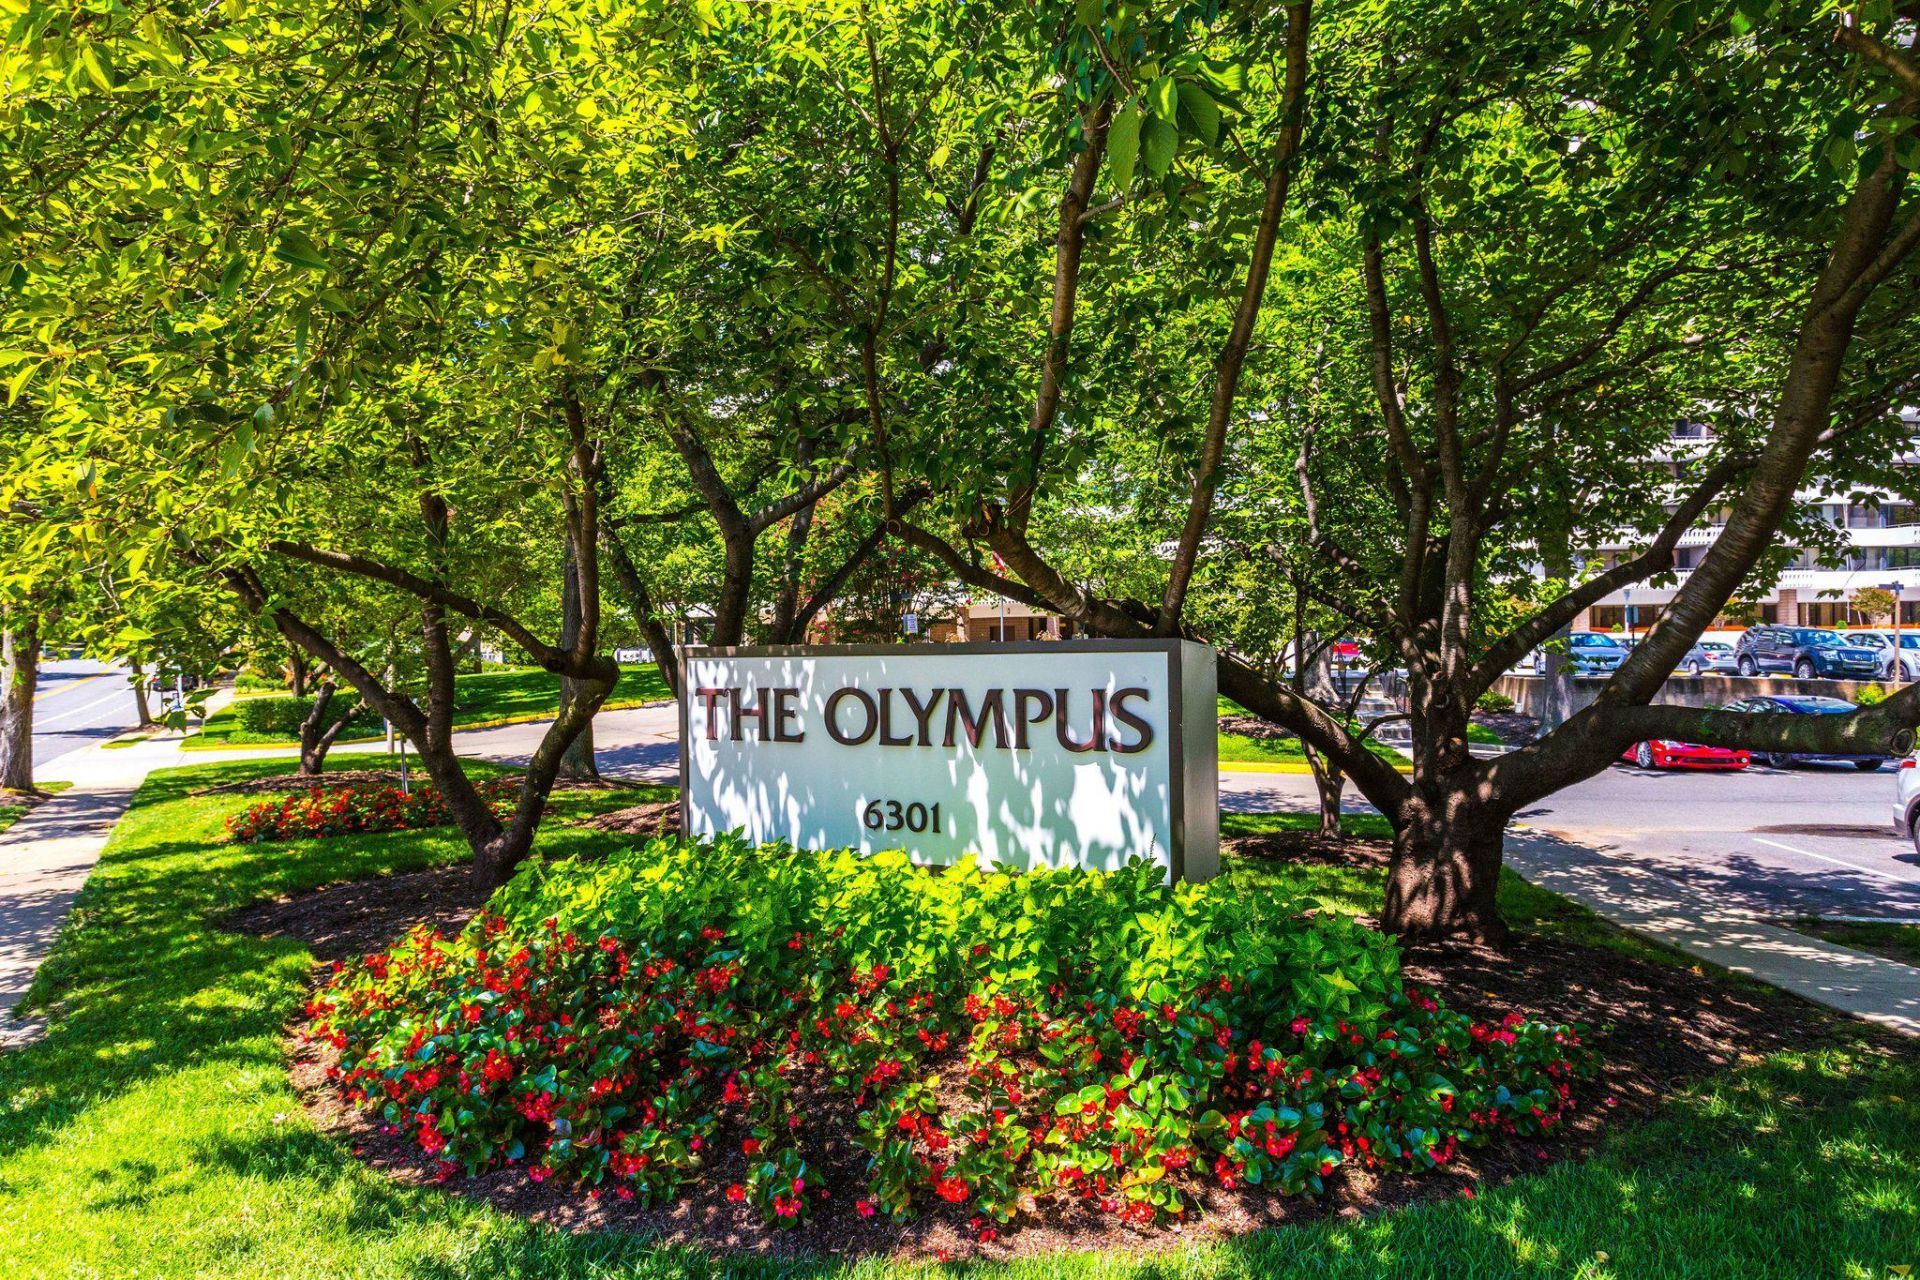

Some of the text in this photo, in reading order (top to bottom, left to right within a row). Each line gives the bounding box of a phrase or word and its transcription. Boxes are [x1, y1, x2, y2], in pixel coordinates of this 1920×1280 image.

[696, 687, 1154, 753] THE OLYMPUS
[863, 799, 941, 834] 6301
